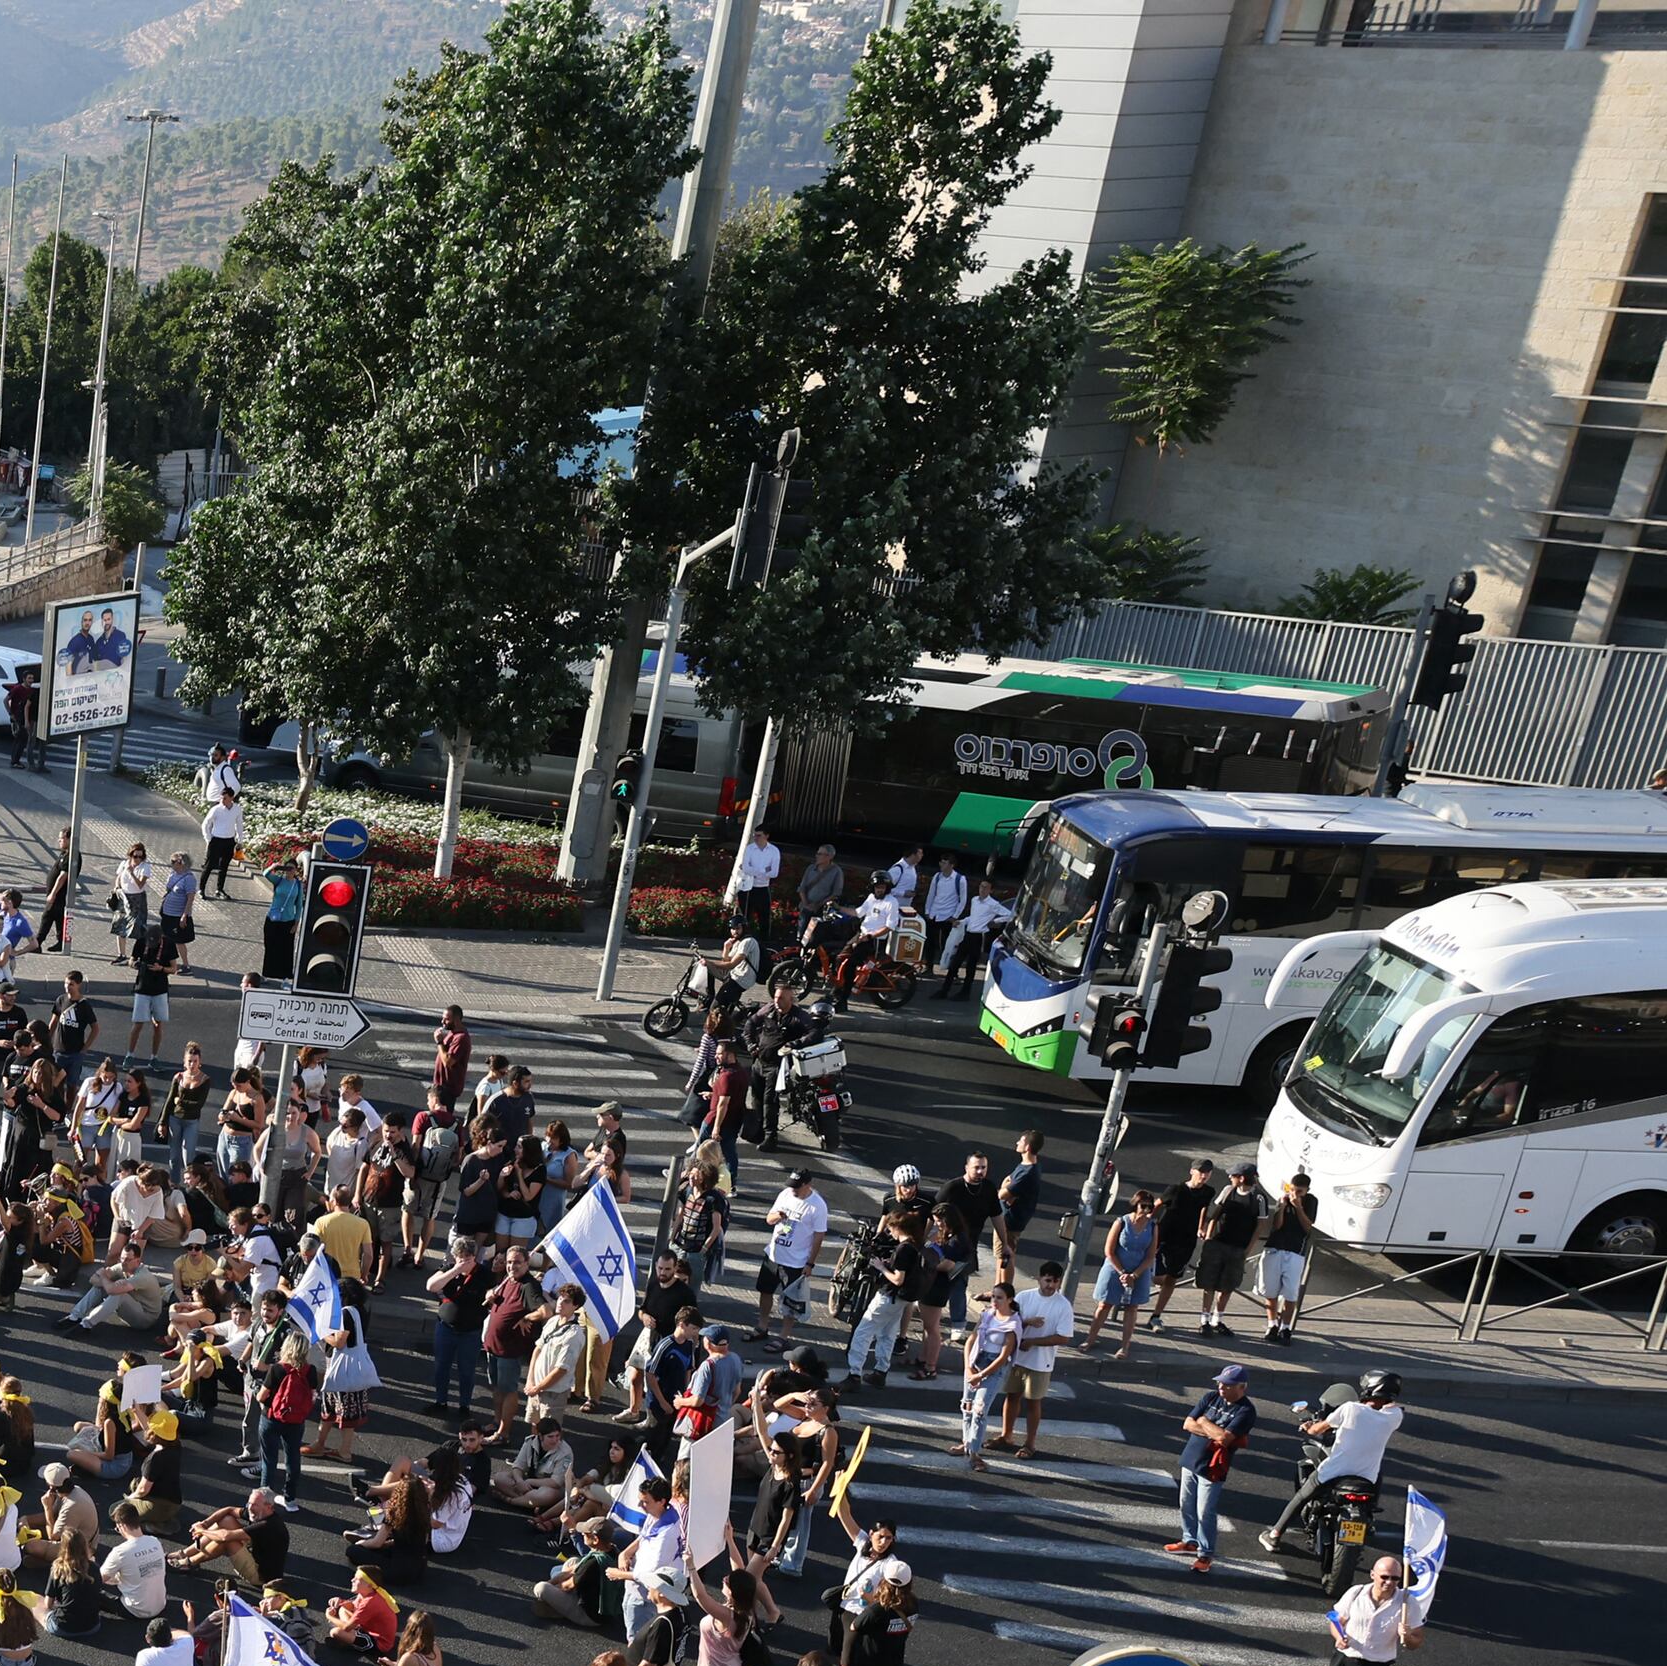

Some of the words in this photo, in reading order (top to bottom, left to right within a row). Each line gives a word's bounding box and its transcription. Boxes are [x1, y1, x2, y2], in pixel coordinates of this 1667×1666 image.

[54, 698, 69, 709] הפה
[71, 694, 98, 706] ושיקום
[55, 705, 123, 725] 02-6526-226
[954, 734, 1096, 777] סופרבוס
[957, 761, 977, 774] דרך
[980, 765, 1000, 777] בכל
[1002, 767, 1029, 781] איתך
[1399, 916, 1461, 957] Dolphin
[278, 998, 315, 1012] מרכזית
[320, 1002, 349, 1015] תחנה
[277, 1014, 310, 1026] المركزية
[315, 1017, 347, 1027] المحطة
[275, 1027, 308, 1039] Central
[313, 1030, 345, 1042] Station
[1582, 1098, 1596, 1112] i6
